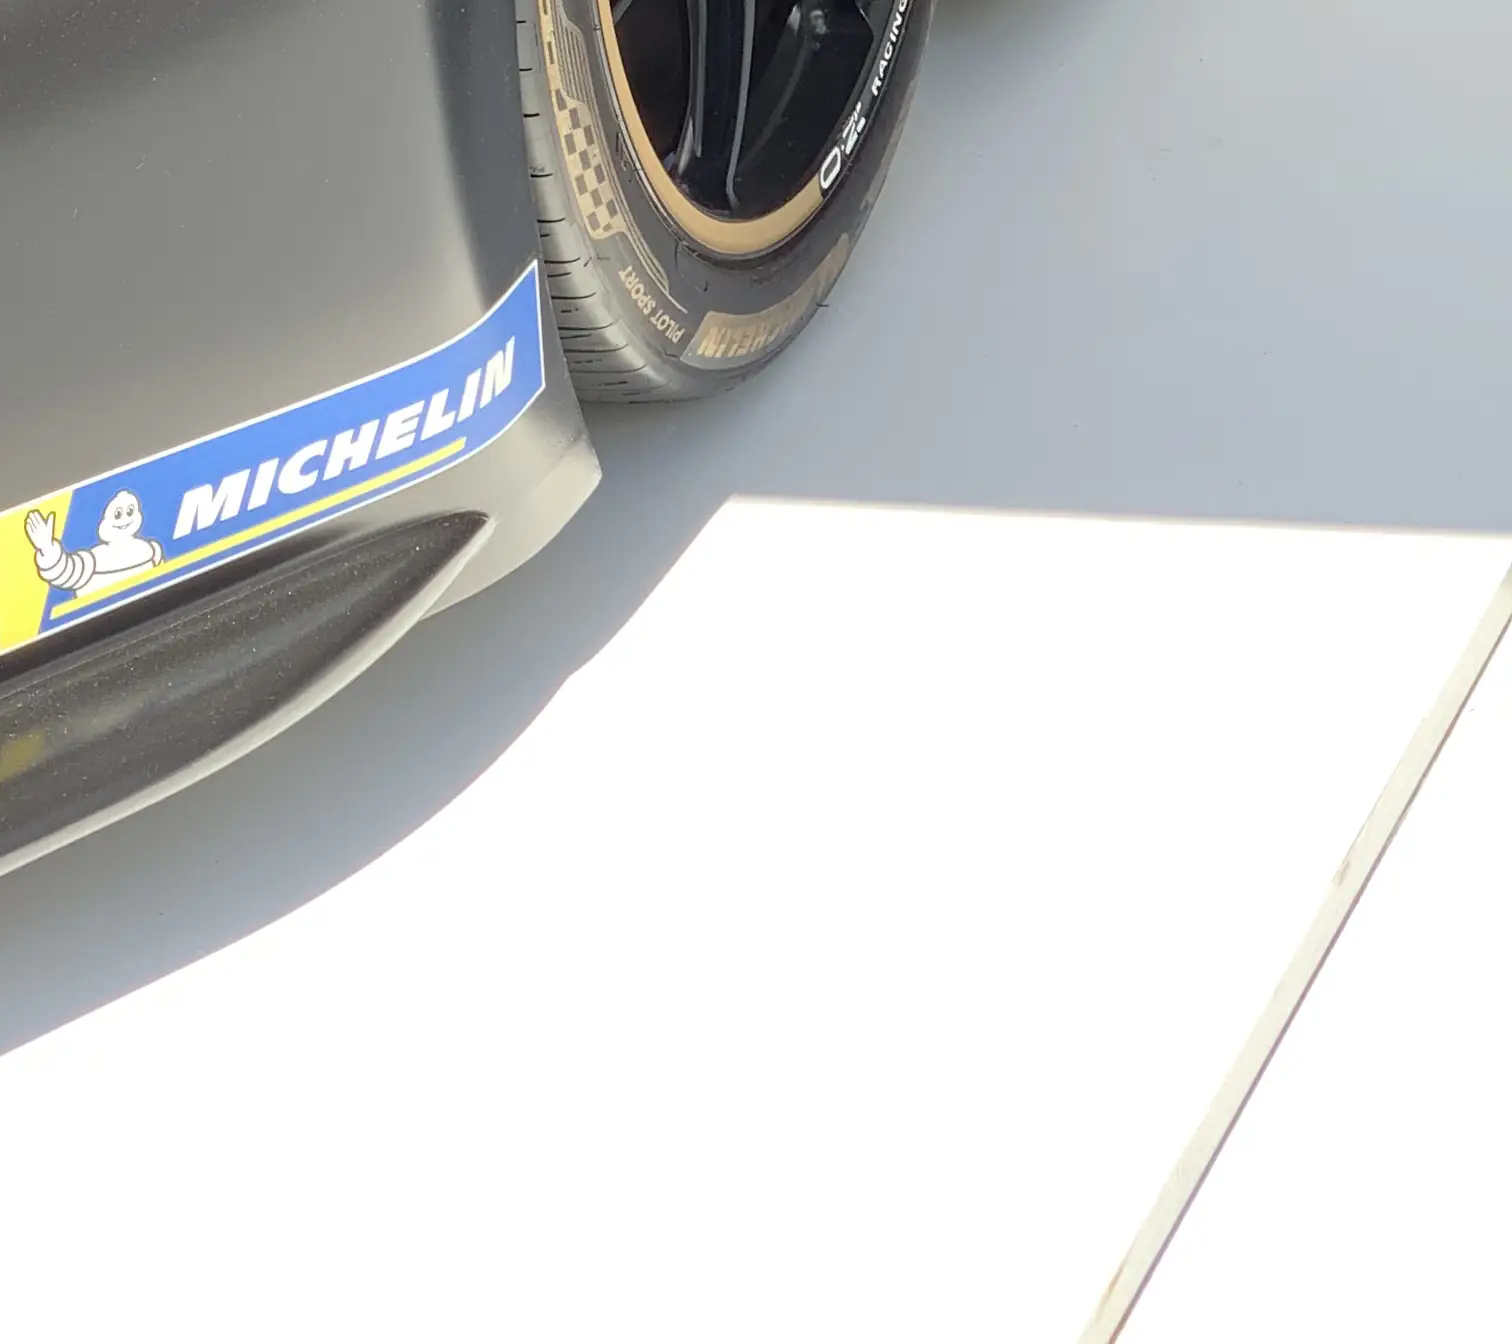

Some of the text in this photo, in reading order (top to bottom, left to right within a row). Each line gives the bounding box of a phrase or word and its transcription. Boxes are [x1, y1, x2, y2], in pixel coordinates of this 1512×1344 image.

[617, 264, 686, 345] PILOT SPORT
[172, 335, 516, 541] MICHELIN
